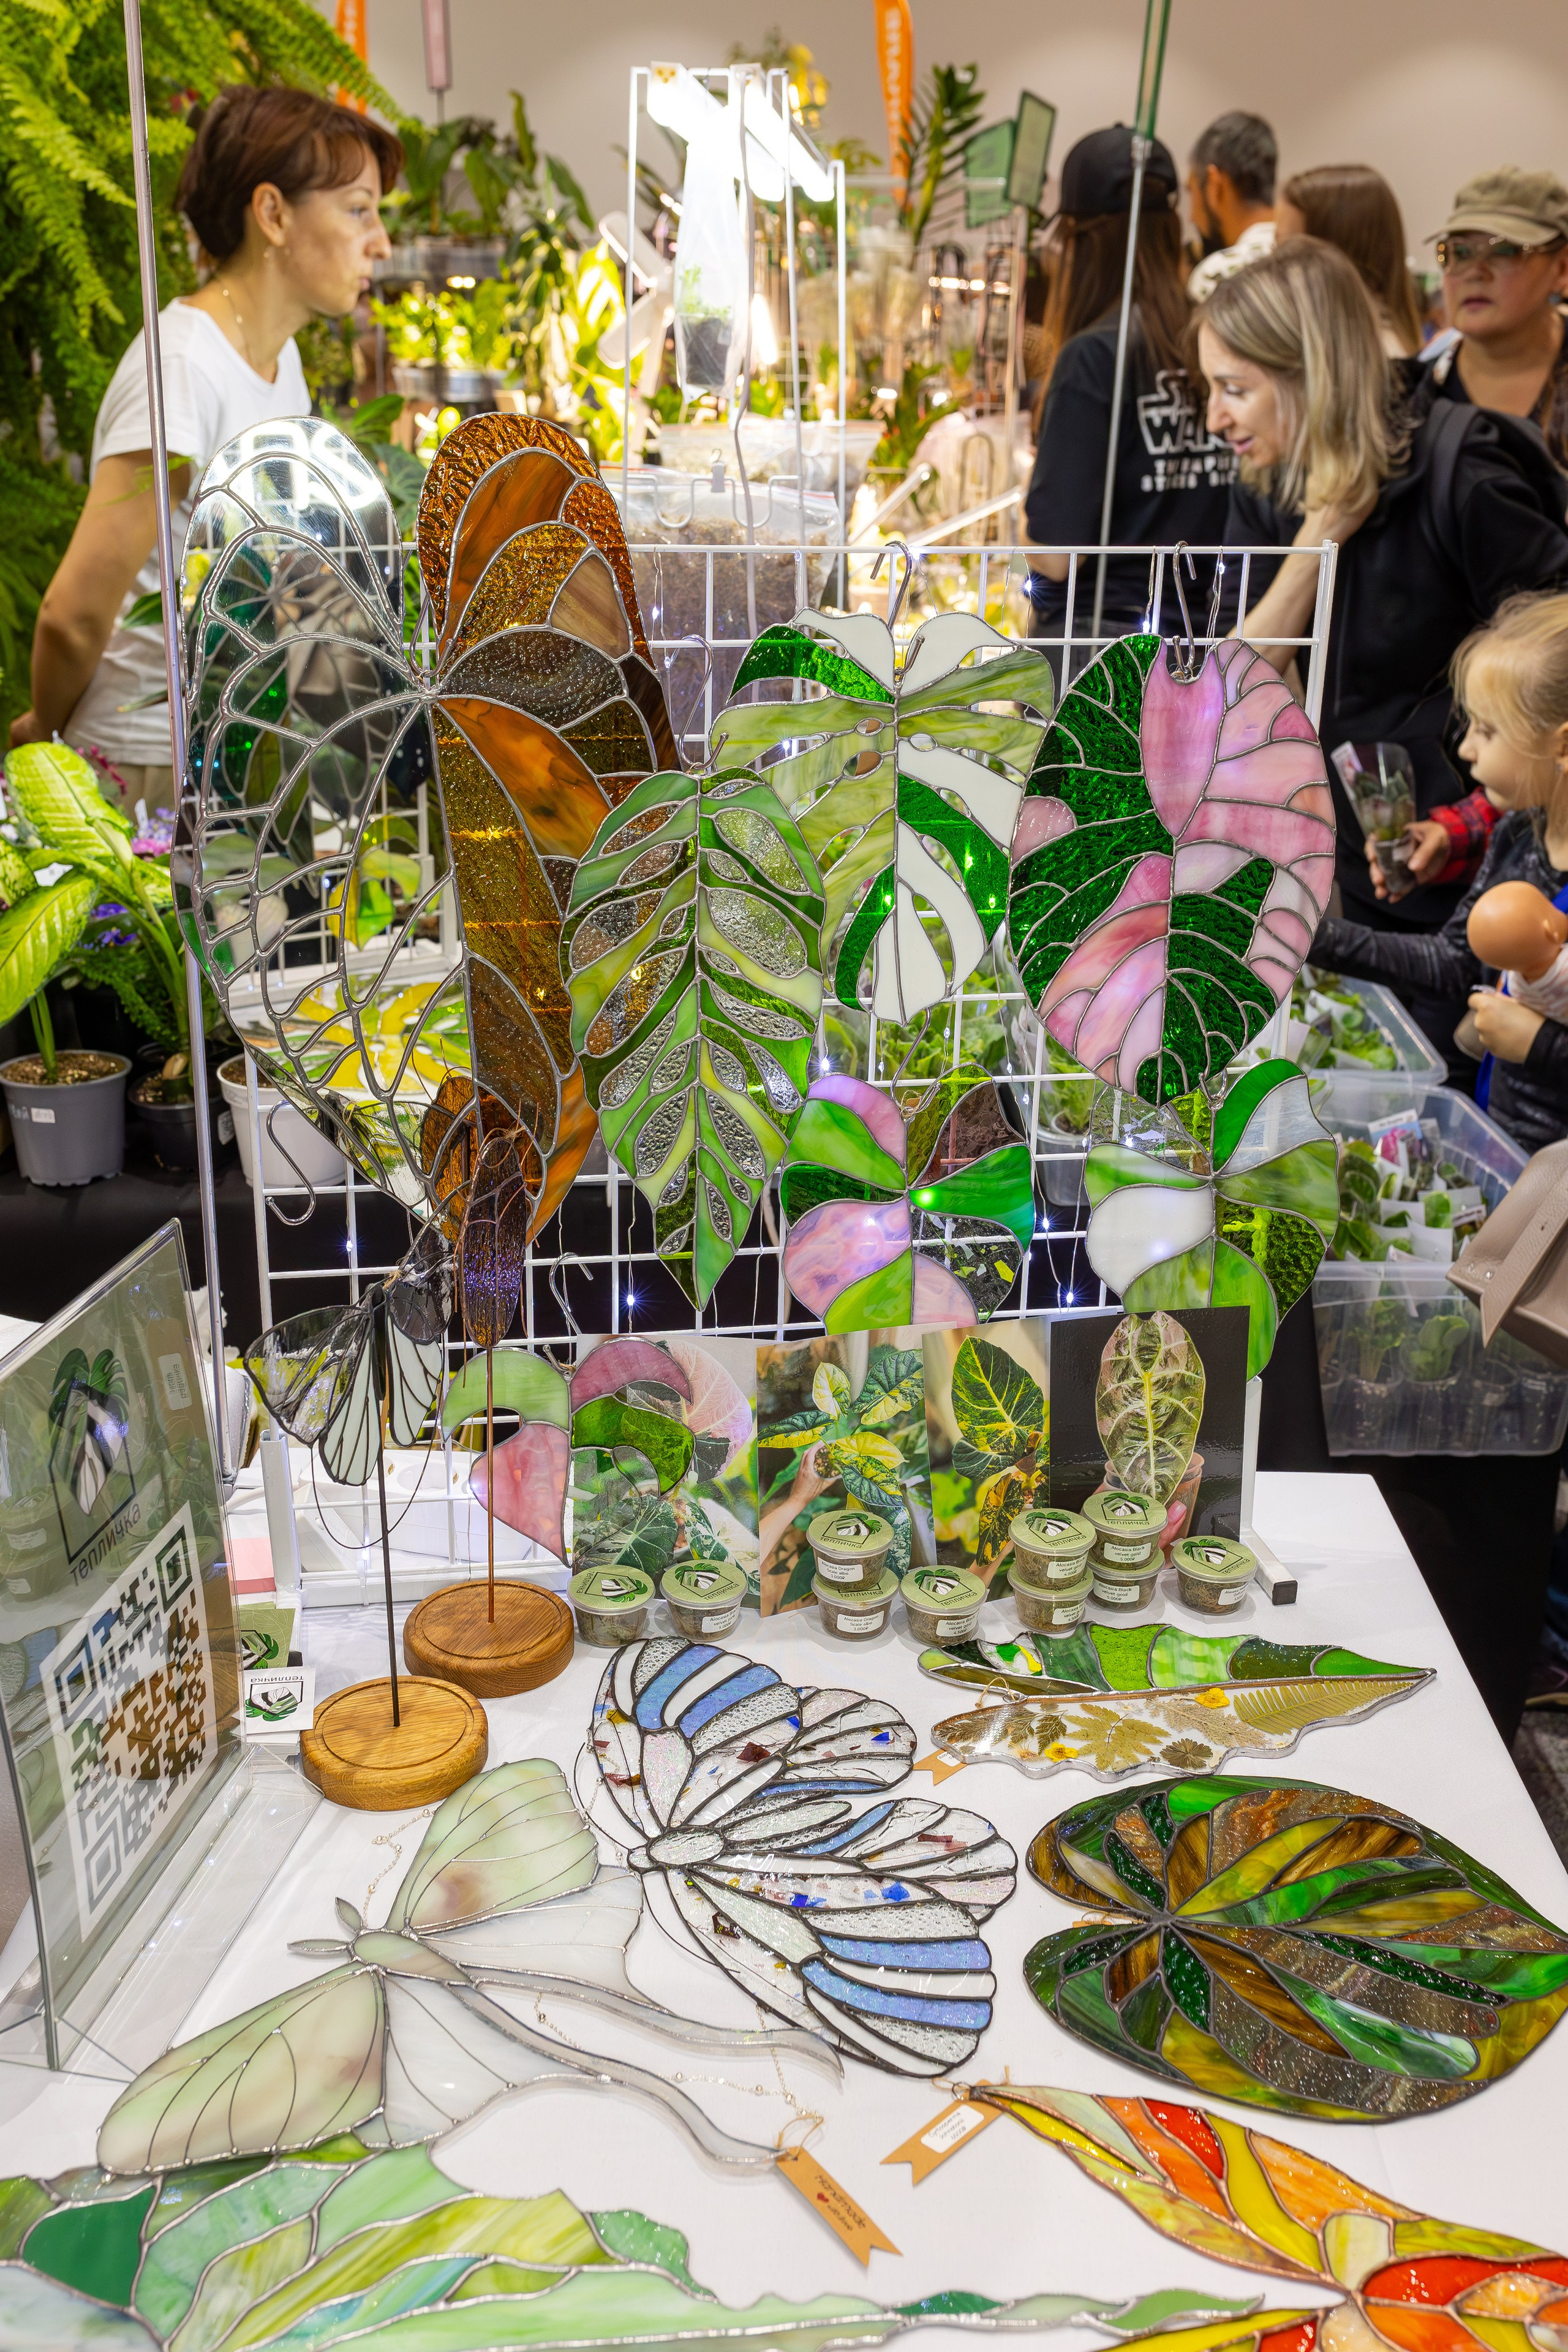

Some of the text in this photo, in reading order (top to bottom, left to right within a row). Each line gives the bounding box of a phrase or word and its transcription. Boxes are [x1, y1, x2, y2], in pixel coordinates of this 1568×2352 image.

[70, 1502, 141, 1587] тепличка
[820, 1537, 863, 1549] тепличка
[1048, 1534, 1087, 1548] тепличка
[821, 1561, 837, 1571] Alocasia
[1221, 1558, 1251, 1576] тепличка
[576, 1571, 595, 1594] тепличка
[1098, 1583, 1118, 1591] Alocasia
[703, 1583, 740, 1601] тепличка
[839, 1590, 884, 1599] тепличка
[940, 1591, 978, 1607] тепличка
[251, 1675, 304, 1683] тепличка
